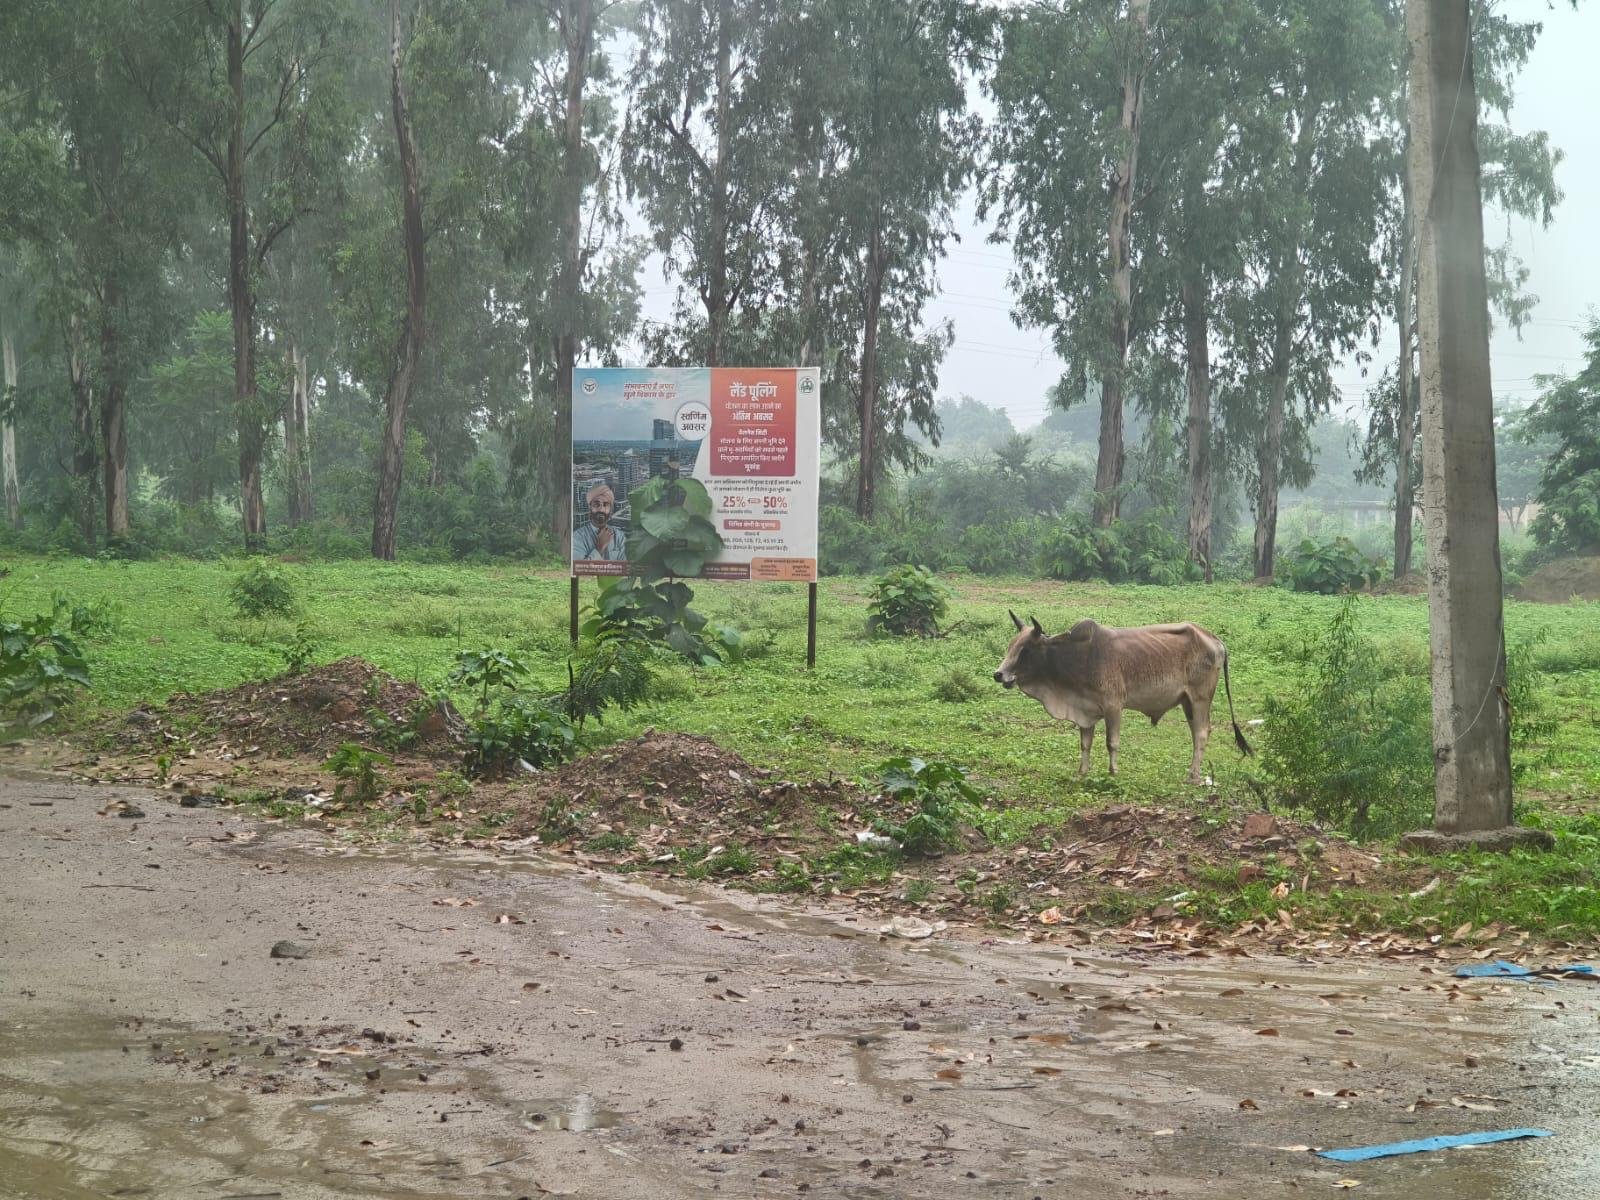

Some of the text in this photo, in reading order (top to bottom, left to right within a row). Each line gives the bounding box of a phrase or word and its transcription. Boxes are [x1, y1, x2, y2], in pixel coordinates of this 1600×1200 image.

[637, 391, 657, 399] विकास
[749, 381, 778, 401] पूलिंग
[752, 412, 774, 421] अवसर
[681, 424, 706, 432] अवसर
[723, 496, 746, 508] 25%
[763, 496, 788, 508] 50%
